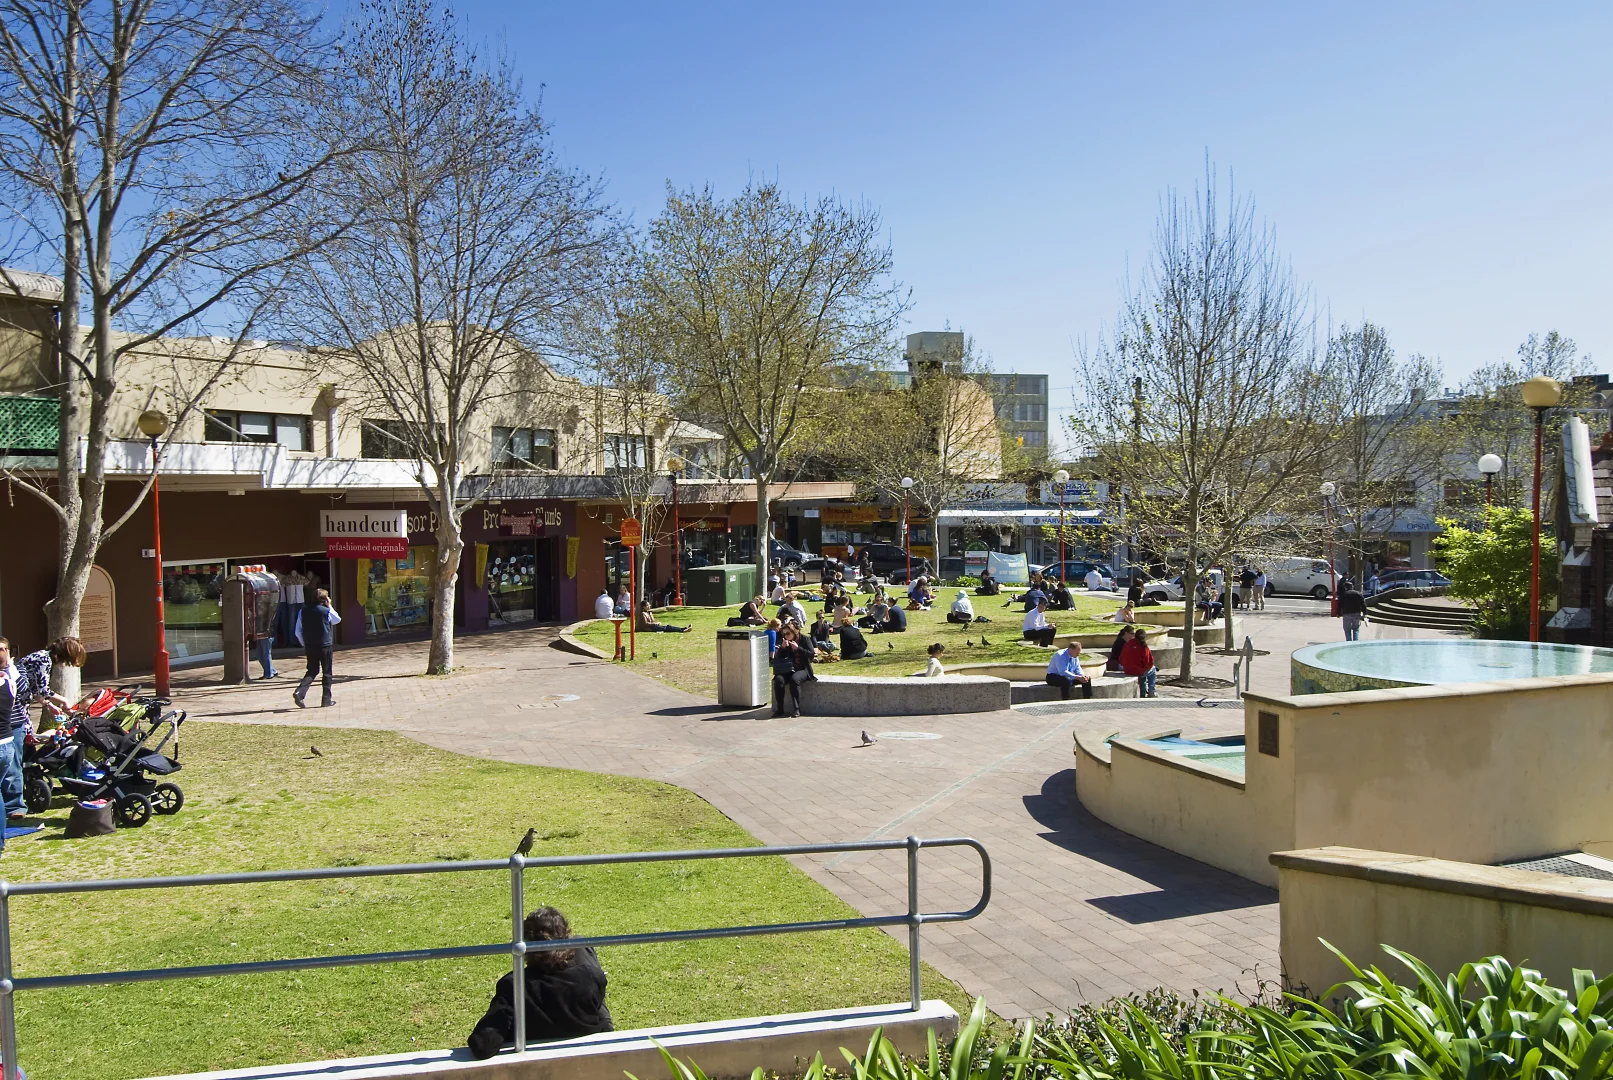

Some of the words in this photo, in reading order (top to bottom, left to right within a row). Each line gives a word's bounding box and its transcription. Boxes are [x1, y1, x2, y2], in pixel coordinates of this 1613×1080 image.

[325, 515, 399, 533] handcut
[328, 541, 371, 552] refashioned
[372, 543, 405, 555] originals
